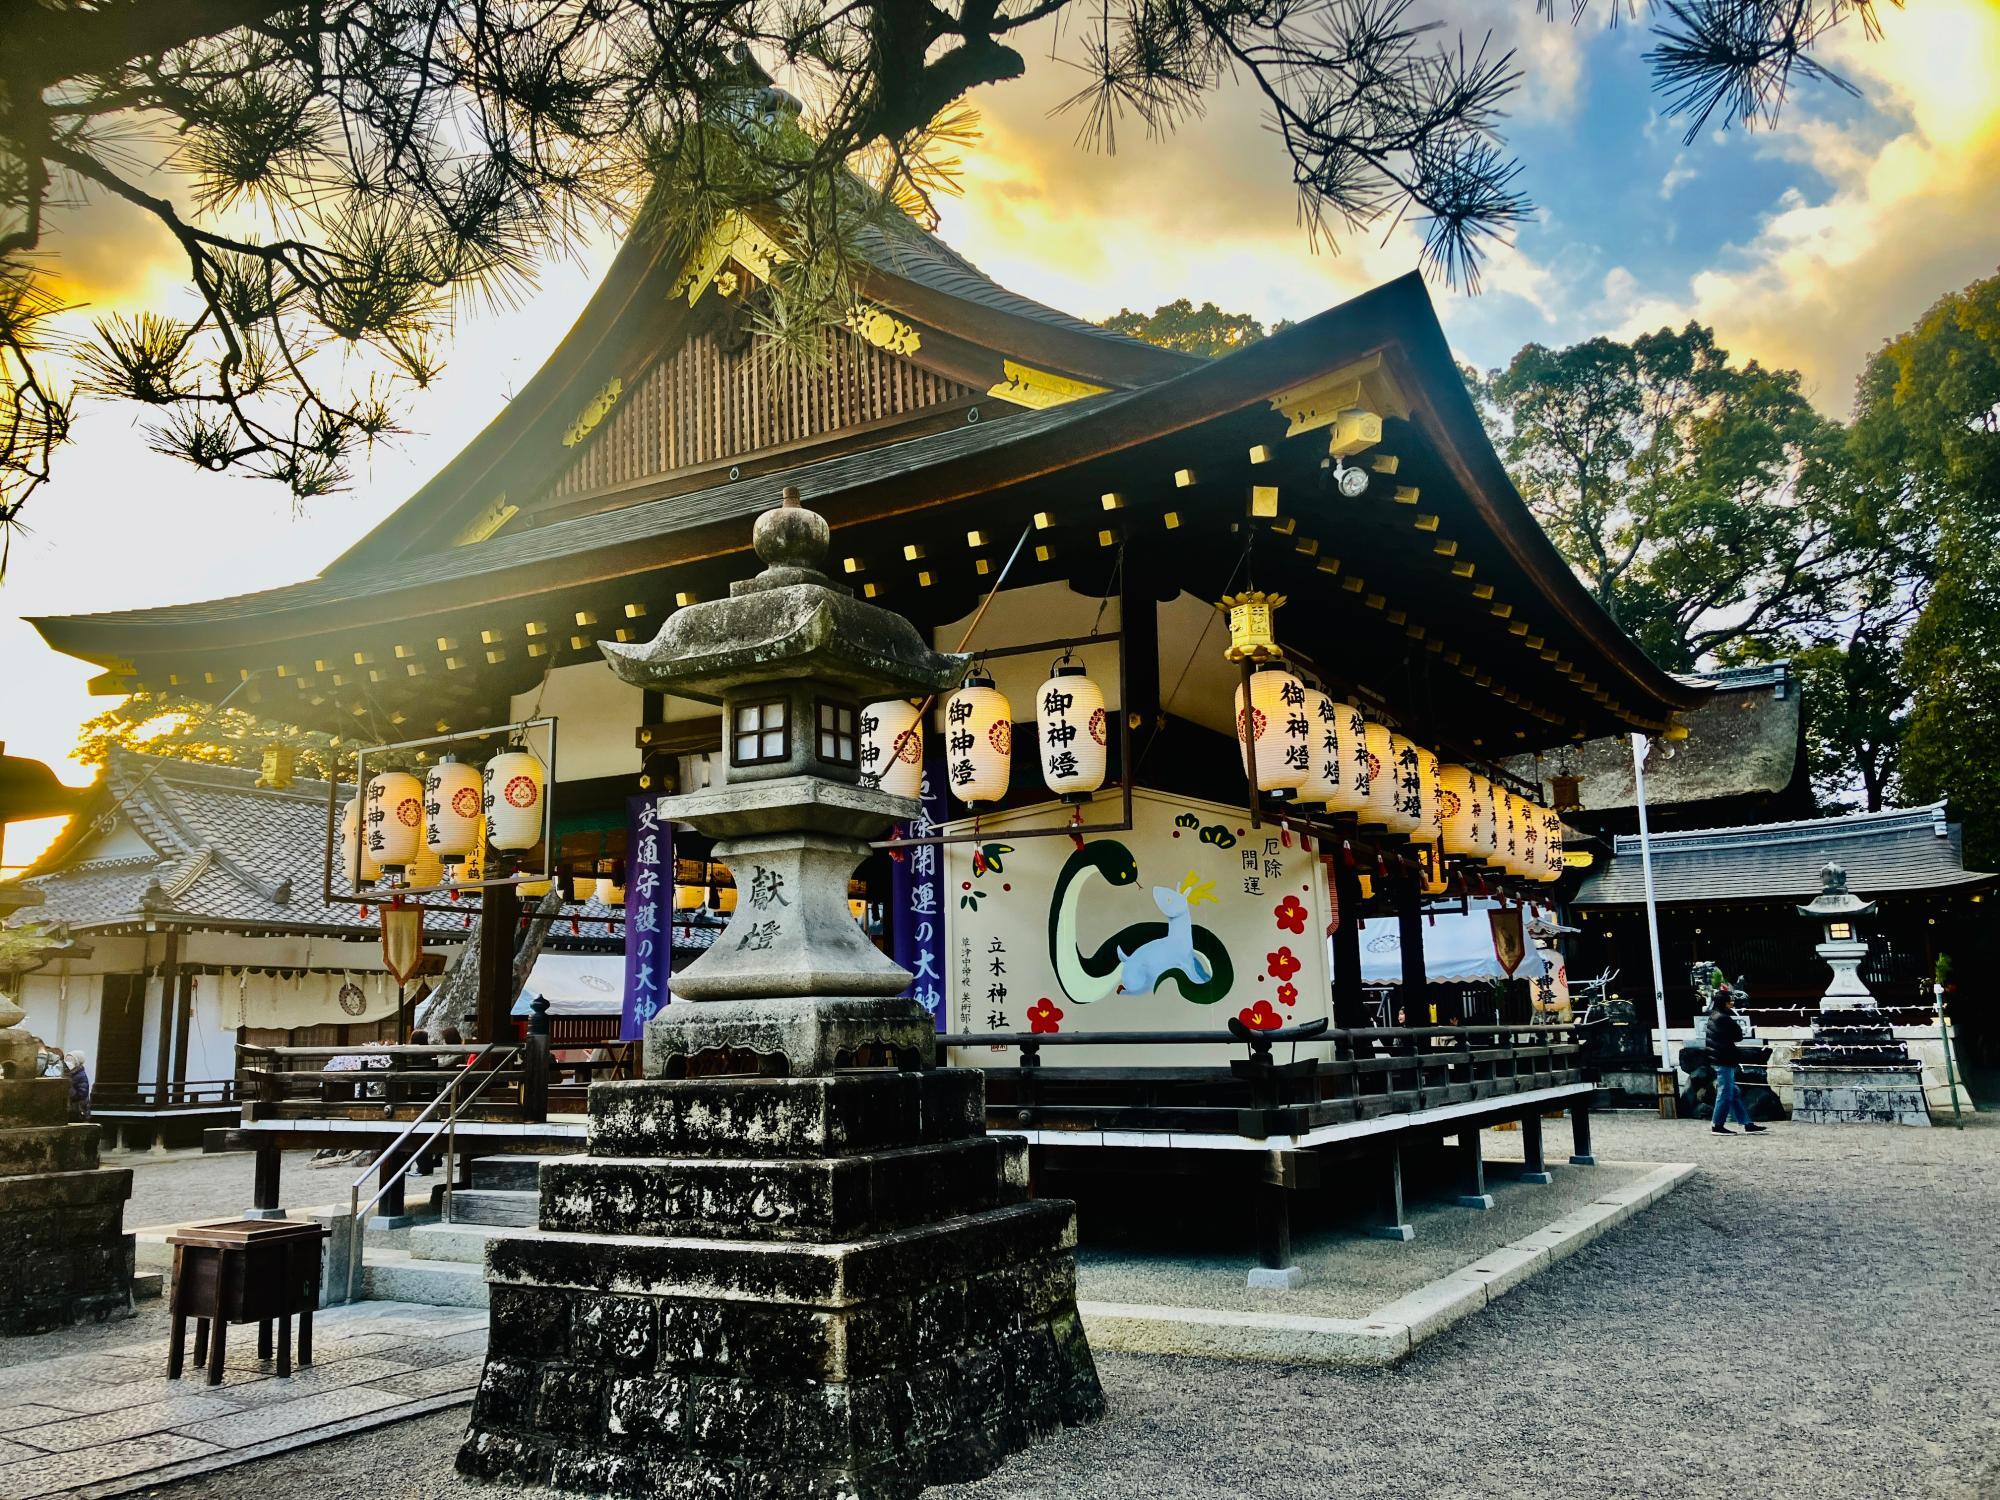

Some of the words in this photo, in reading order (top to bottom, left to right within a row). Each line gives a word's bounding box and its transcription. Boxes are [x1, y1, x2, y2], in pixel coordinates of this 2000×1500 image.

[949, 697, 976, 786] 御神燈
[1042, 688, 1079, 778] 御神燈
[1279, 680, 1309, 770] 御神燈
[1241, 849, 1265, 896] 開運
[1262, 838, 1284, 879] 厄除
[634, 802, 661, 1025] 交通守護の大神
[986, 936, 1011, 1031] 立木神社
